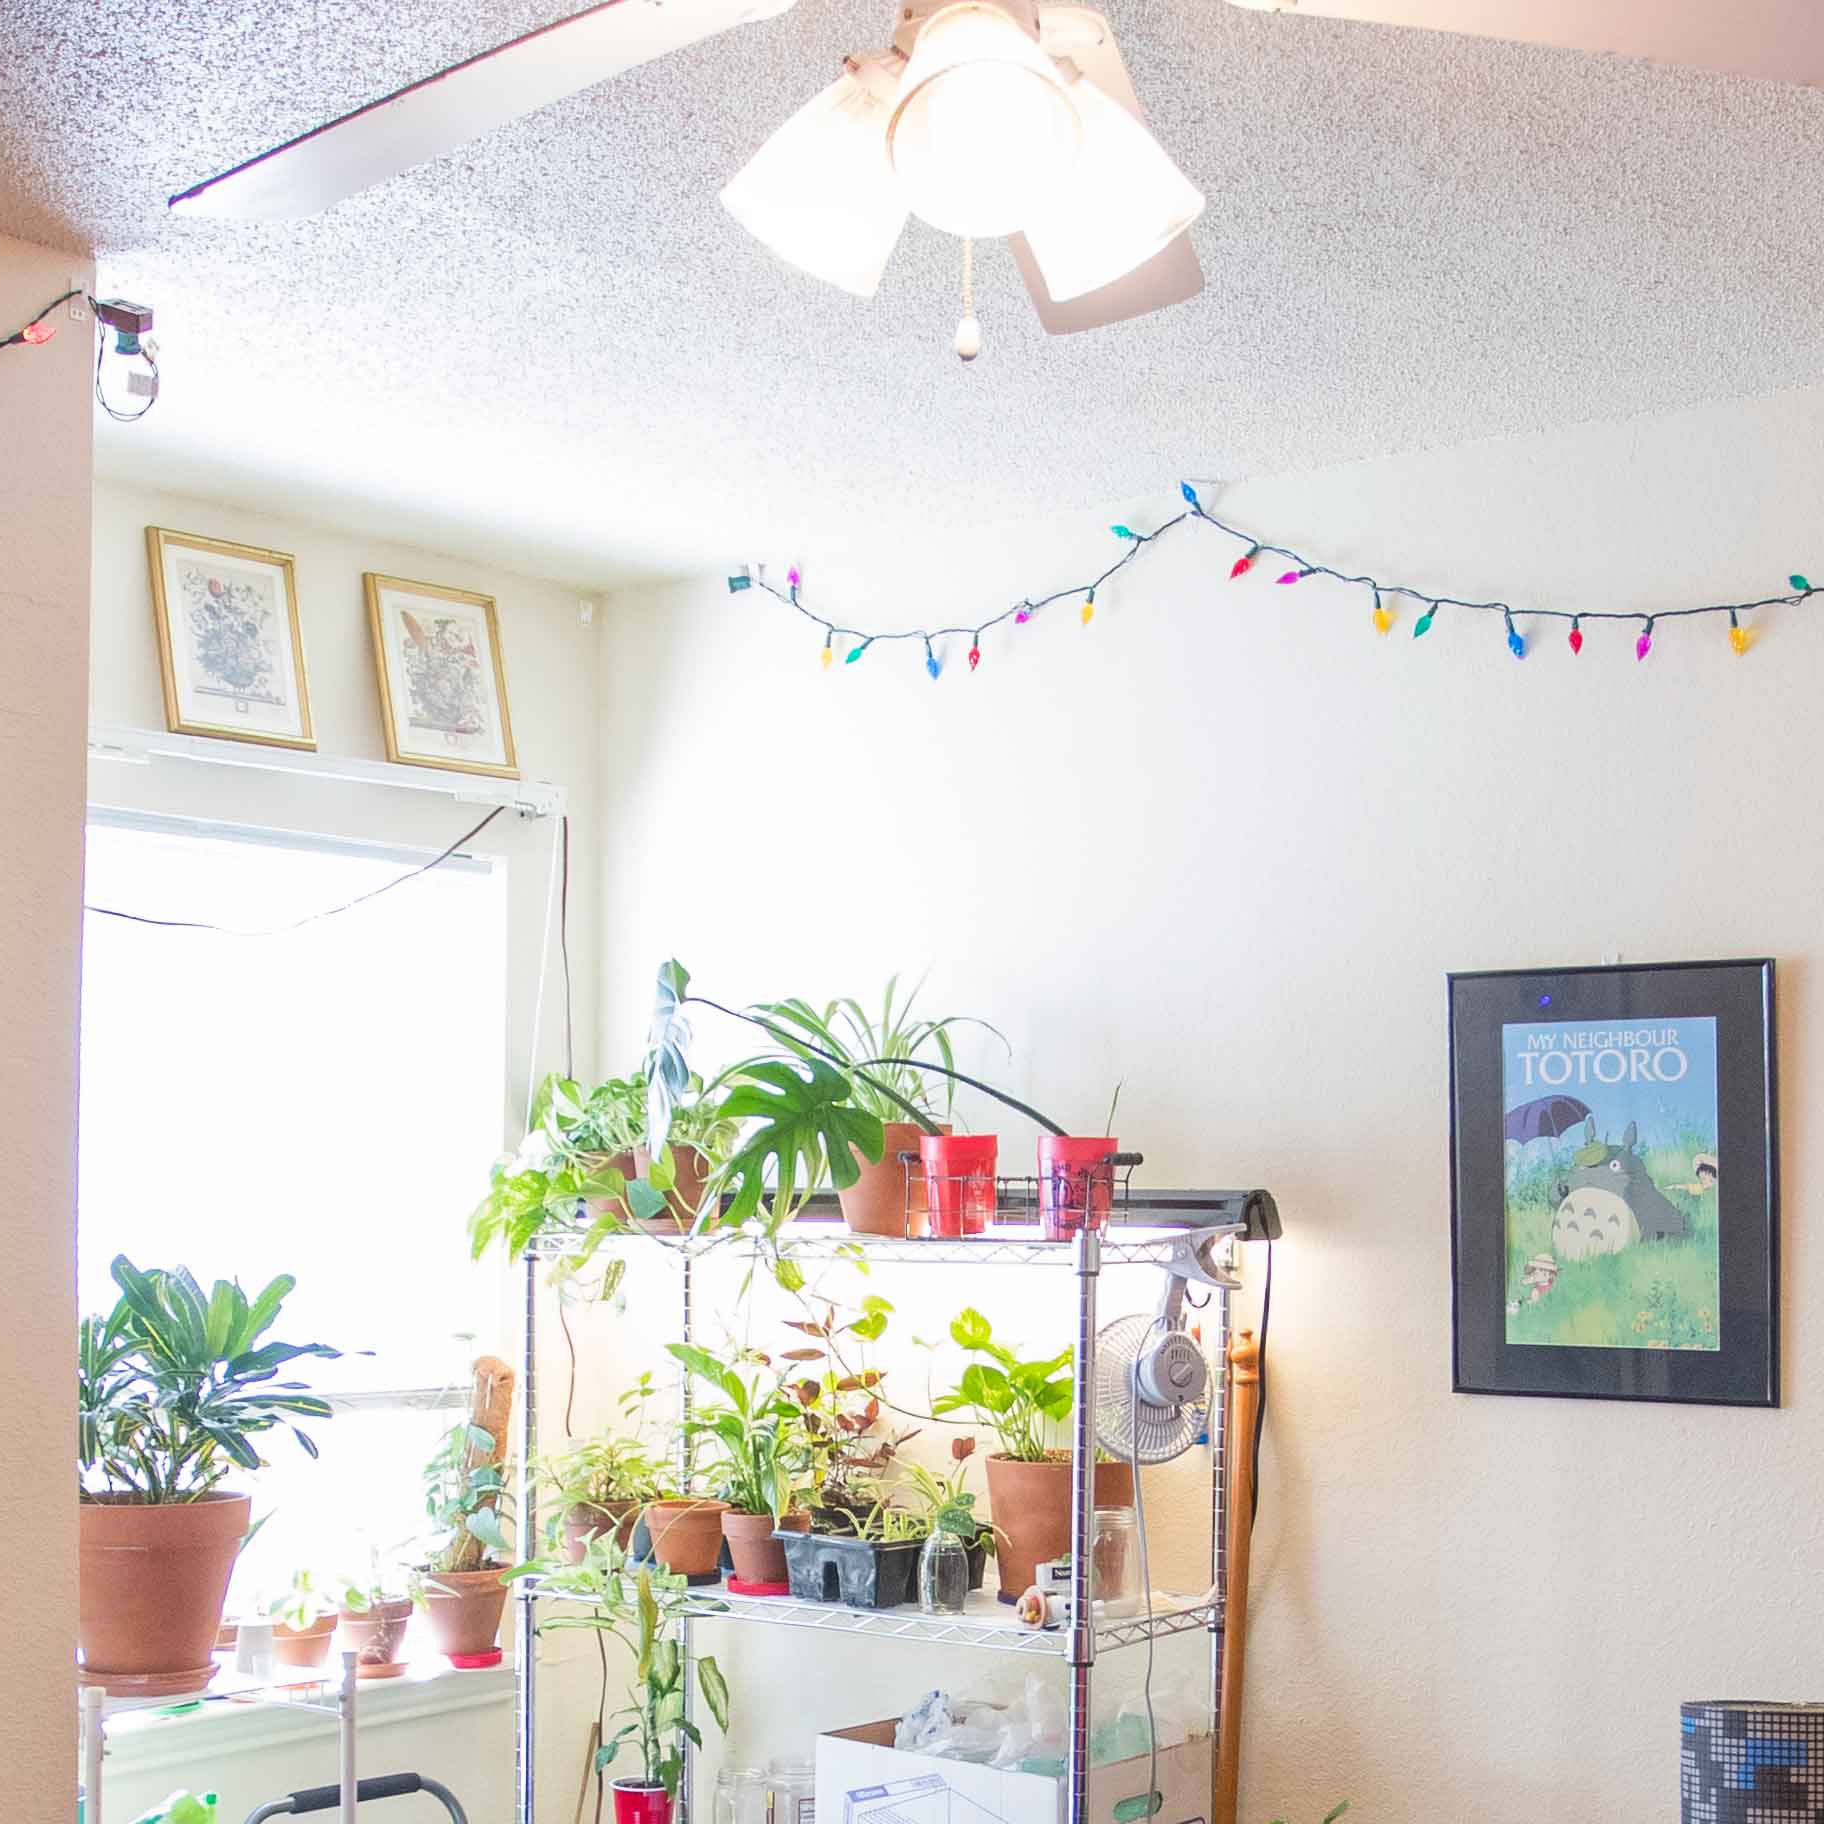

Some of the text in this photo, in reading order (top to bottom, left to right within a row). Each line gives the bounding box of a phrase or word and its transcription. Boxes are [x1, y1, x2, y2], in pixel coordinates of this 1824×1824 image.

[1528, 1029, 1679, 1051] MY NEIGHBOUR
[1518, 1048, 1688, 1086] TOTORO
